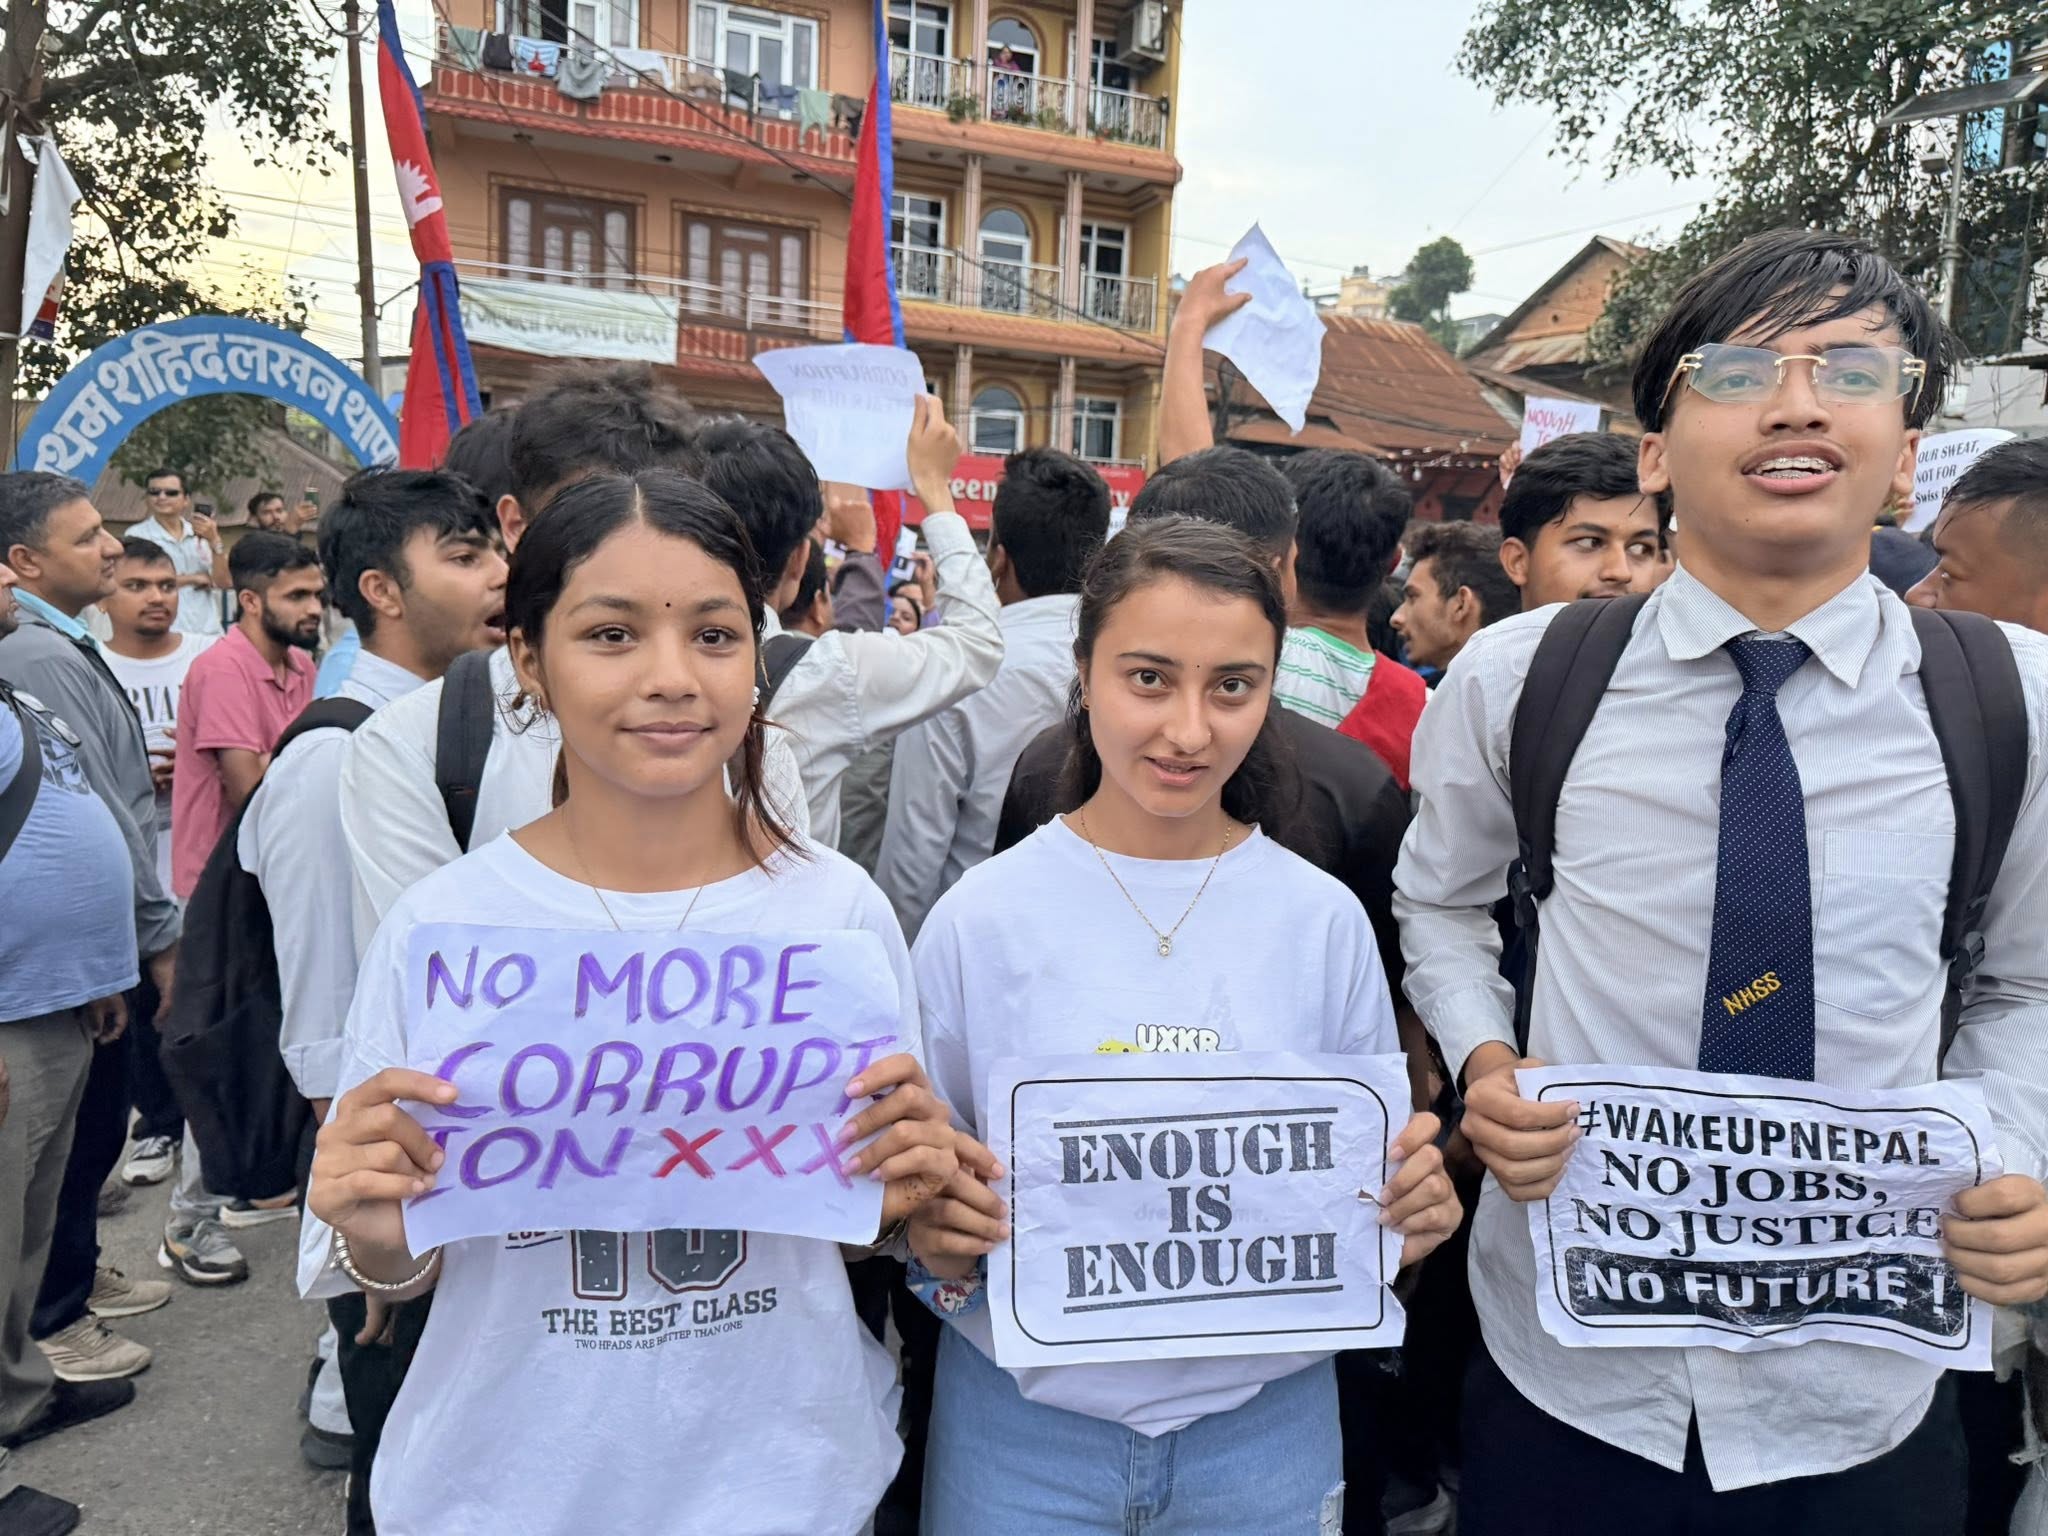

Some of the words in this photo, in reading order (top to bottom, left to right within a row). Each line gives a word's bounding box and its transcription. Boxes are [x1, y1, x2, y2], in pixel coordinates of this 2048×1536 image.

[1915, 489, 1939, 505] Swiss
[1936, 465, 1957, 480] FOR
[426, 944, 537, 1009] NO
[574, 943, 822, 1029] MORE
[1722, 971, 1782, 1016] NHSS
[432, 1035, 897, 1119] CORRUPT
[1059, 1120, 1335, 1184] ENOUGH
[1574, 1100, 1941, 1166] #WAKEUPNEPAL
[1600, 1149, 1691, 1197] NO
[1701, 1164, 1888, 1208] JOBS,
[1167, 1184, 1233, 1234] IS
[1570, 1198, 1662, 1243] NO
[1669, 1206, 1943, 1257] JUSTICE
[1063, 1232, 1337, 1299] ENOUGH
[1584, 1262, 1664, 1304] NO
[1685, 1266, 1908, 1309] FUTURE
[542, 1308, 598, 1336] THE
[609, 1303, 682, 1336] BEST
[692, 1287, 777, 1325] CLASS
[574, 1339, 597, 1350] TWO
[634, 1339, 656, 1350] ARE
[694, 1324, 721, 1339] THAN
[722, 1320, 743, 1333] ONE
